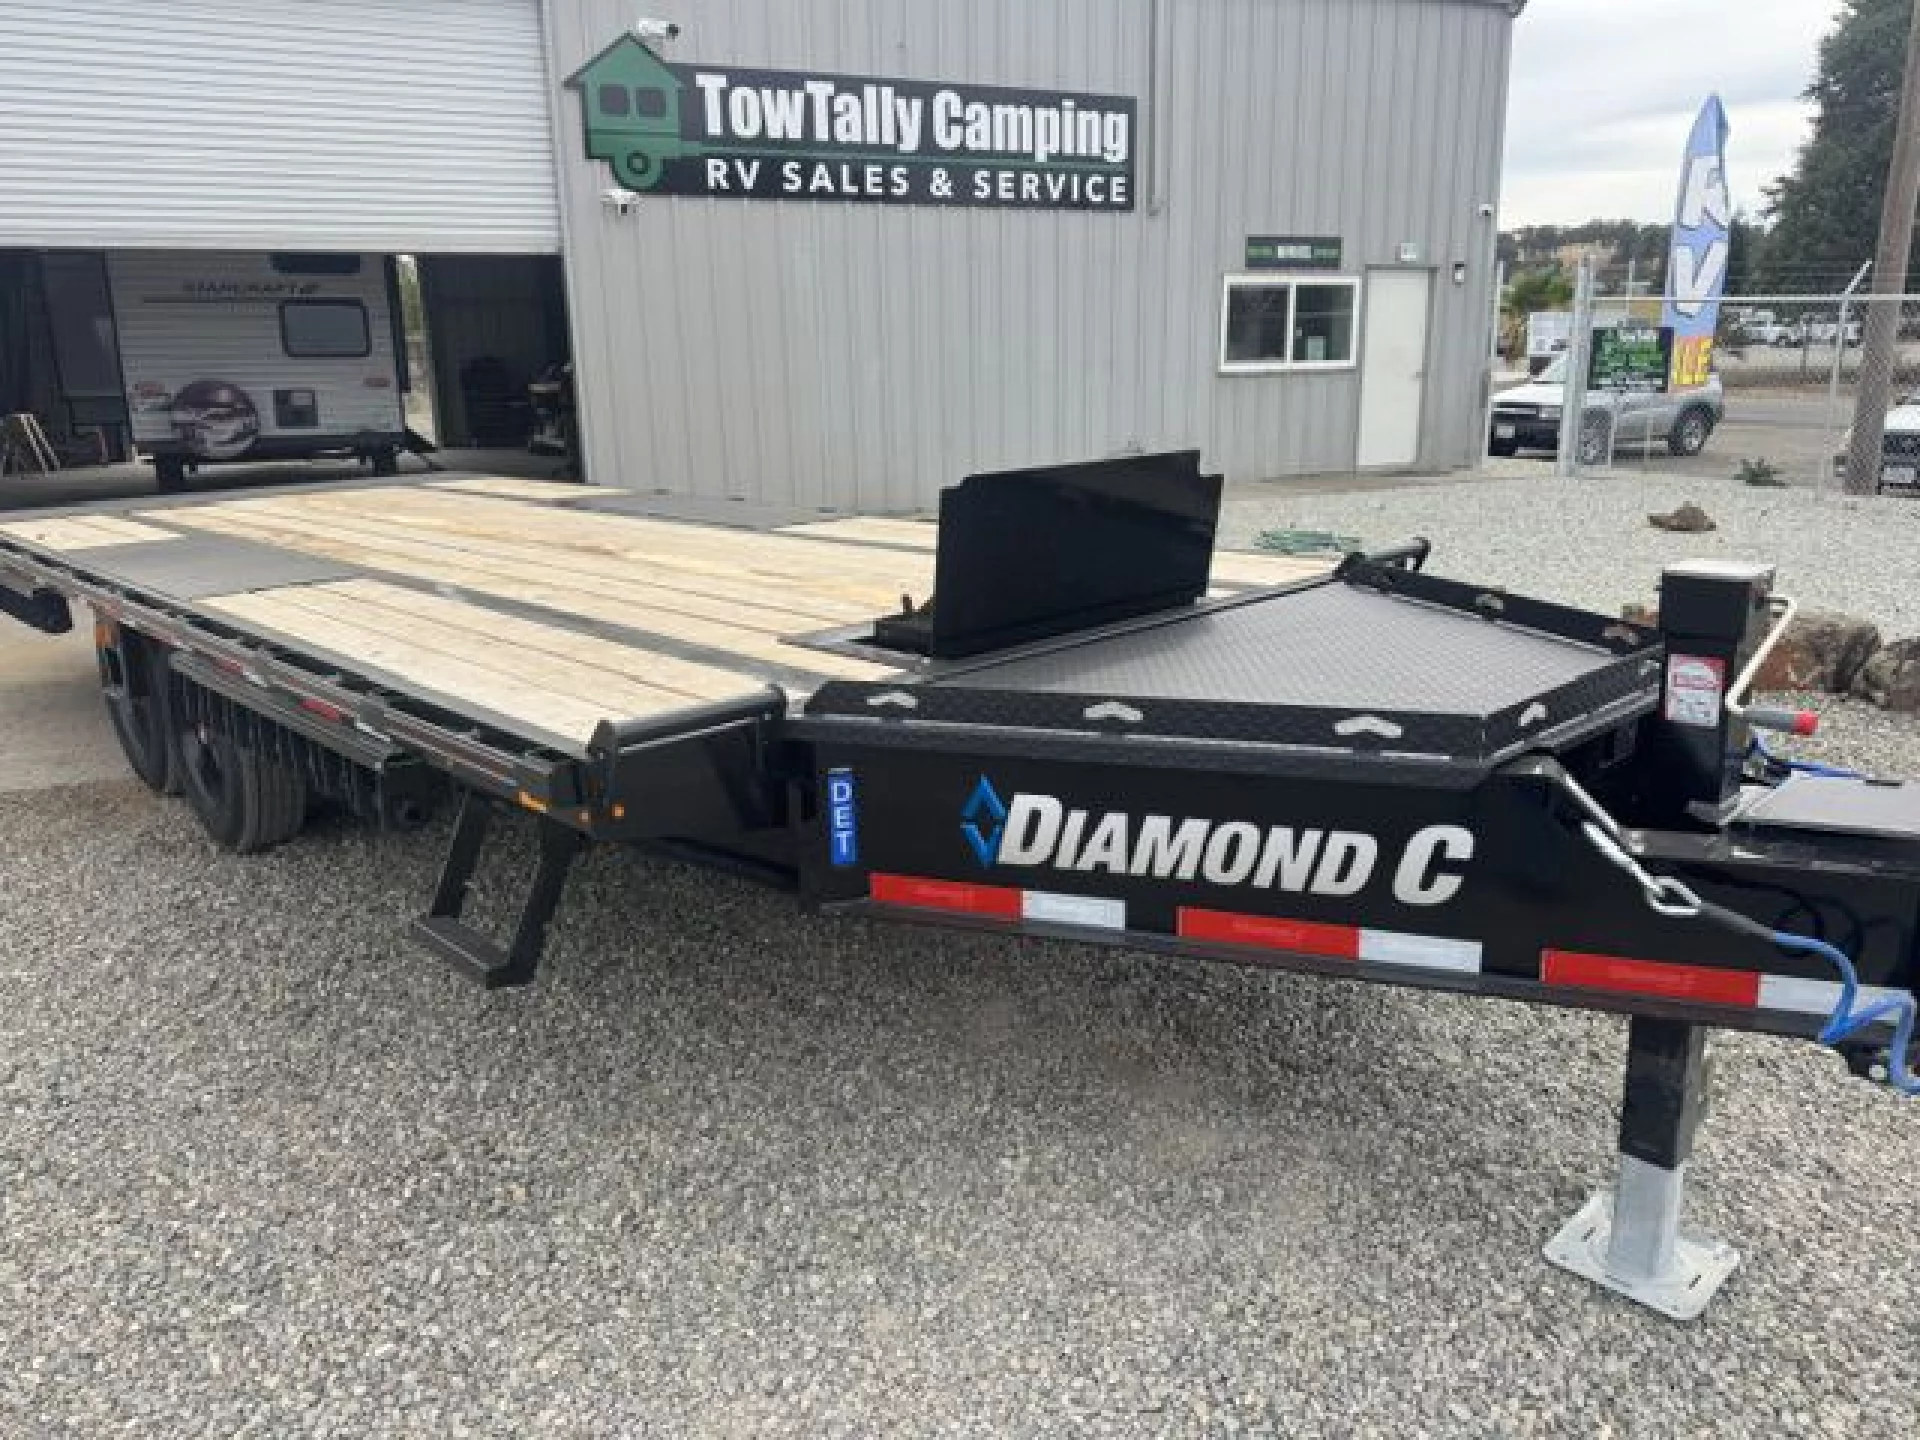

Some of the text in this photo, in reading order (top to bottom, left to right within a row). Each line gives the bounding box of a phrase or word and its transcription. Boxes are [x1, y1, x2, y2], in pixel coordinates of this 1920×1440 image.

[696, 74, 1128, 162] TowTally Camping
[706, 158, 1128, 204] RV SALES & SERVICE
[831, 781, 853, 855] DET
[996, 792, 1475, 905] DIAMOND C
